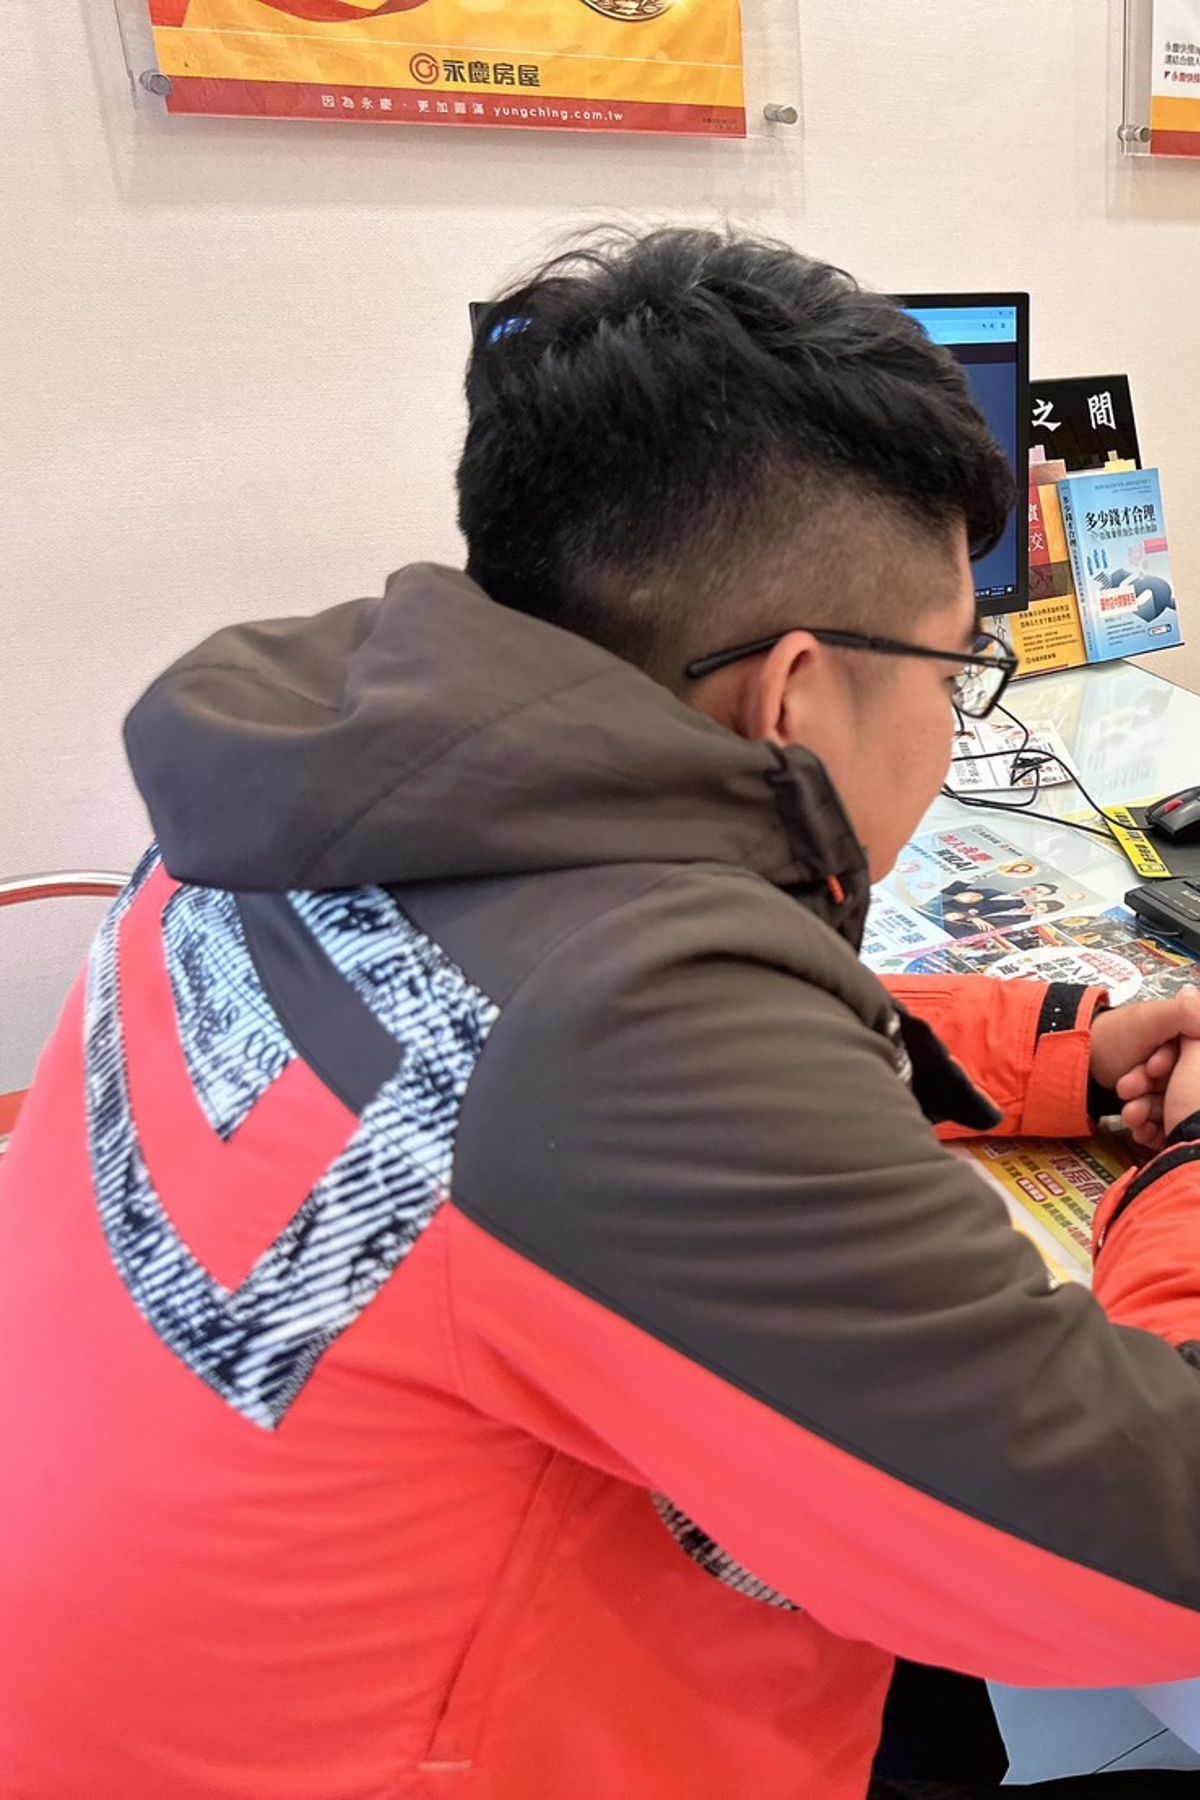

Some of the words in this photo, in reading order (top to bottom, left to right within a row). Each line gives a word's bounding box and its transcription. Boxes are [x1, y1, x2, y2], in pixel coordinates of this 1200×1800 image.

[443, 59, 541, 88] 永慶房屋
[494, 105, 624, 121] yungching.com.tw
[1084, 503, 1157, 532] 多少錢才合理
